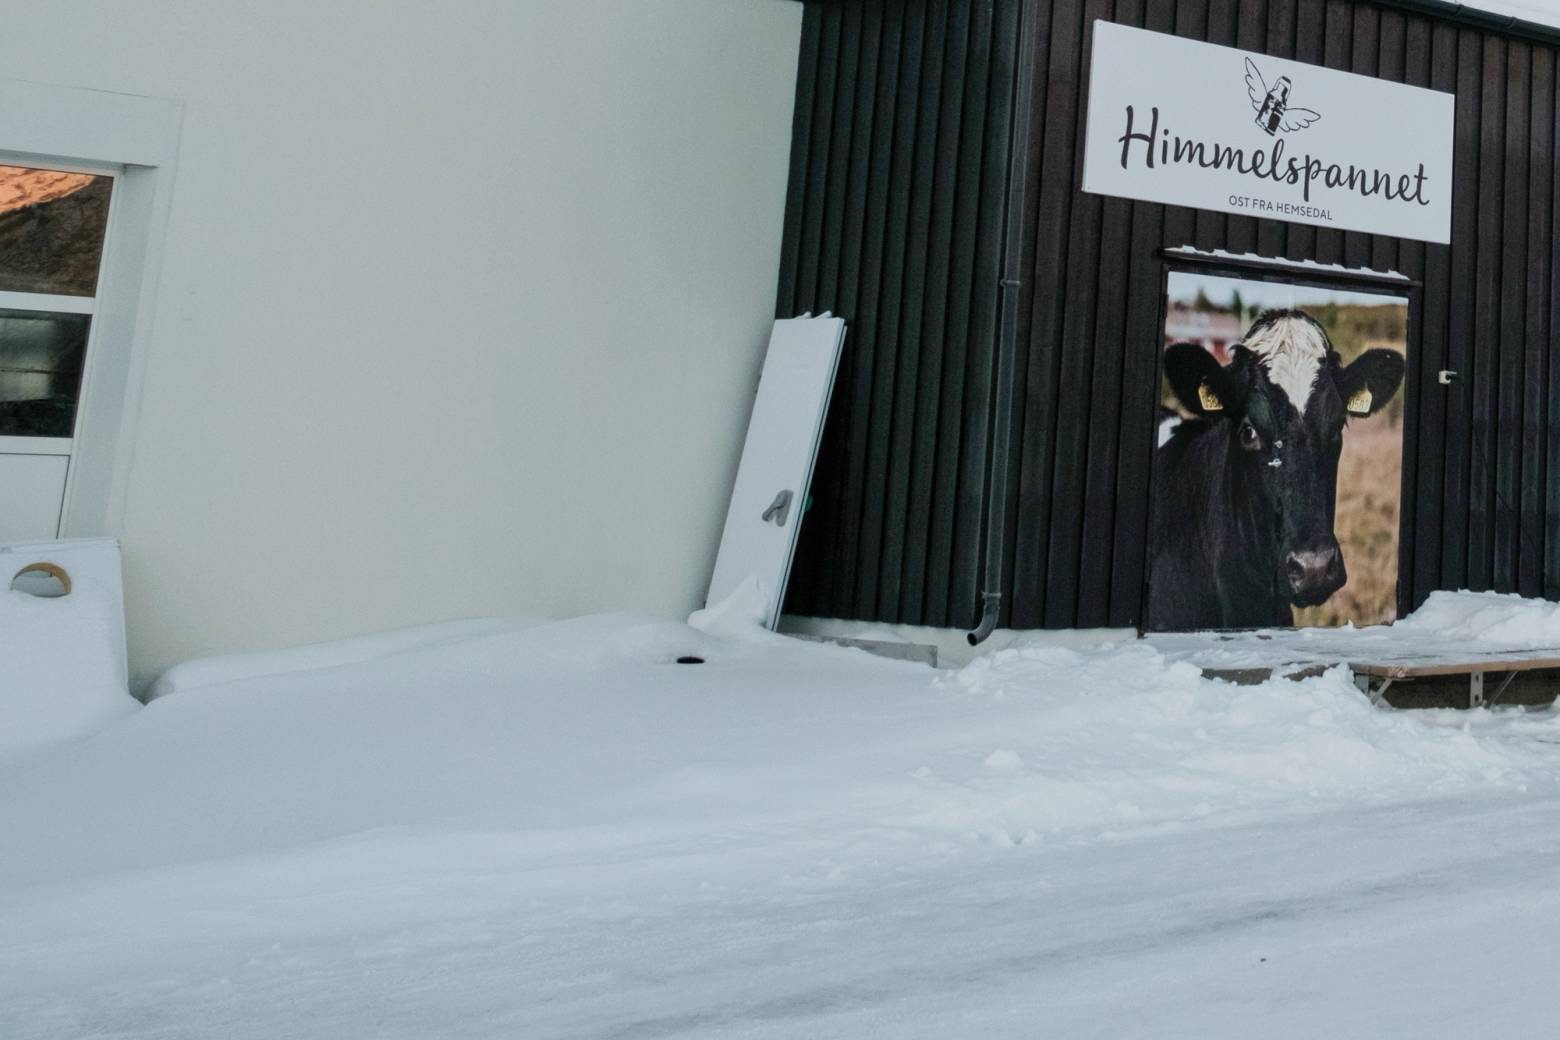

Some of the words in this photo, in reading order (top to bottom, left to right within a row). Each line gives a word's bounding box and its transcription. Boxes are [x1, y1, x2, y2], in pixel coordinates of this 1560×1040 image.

[1118, 104, 1430, 206] Himmelspannet
[1228, 195, 1250, 208] OST
[1252, 199, 1274, 212] FRA
[1276, 202, 1333, 221] HEMSEDAL
